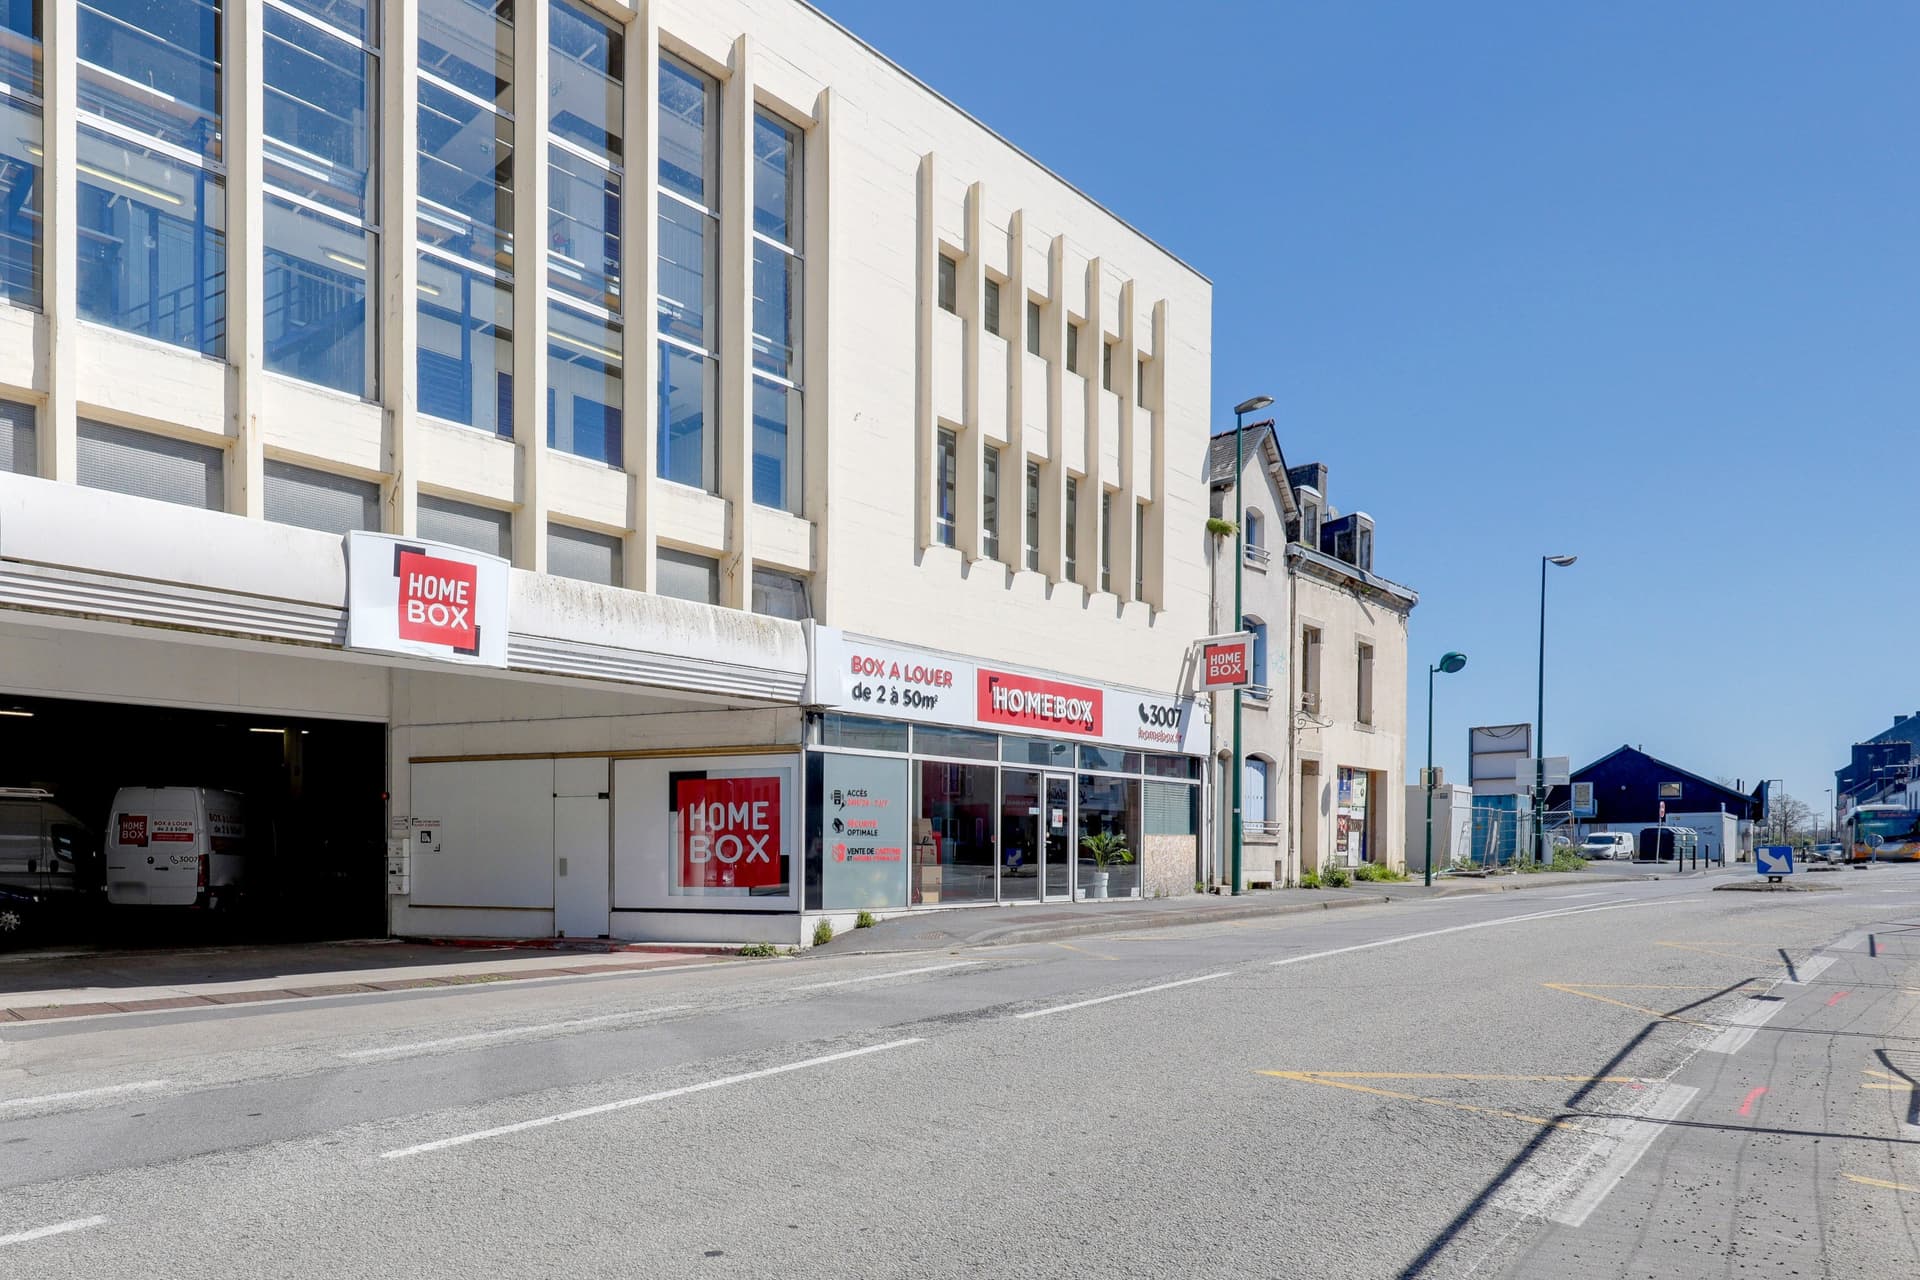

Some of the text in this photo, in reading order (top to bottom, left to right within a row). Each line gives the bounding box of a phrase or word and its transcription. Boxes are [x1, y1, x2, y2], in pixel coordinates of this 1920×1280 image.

[408, 572, 470, 605] HOME
[407, 599, 469, 630] BOX
[1210, 652, 1241, 665] HOME
[1210, 664, 1241, 677] BOX
[851, 655, 953, 688] BOX A LOUER
[852, 681, 872, 702] de
[876, 685, 886, 704] 2
[890, 686, 899, 706] à
[992, 686, 1093, 723] HOMEBOX
[1149, 704, 1182, 729] 3007
[847, 788, 868, 798] ACCÈS
[122, 821, 145, 831] HOME
[689, 801, 769, 832] HOME
[122, 830, 145, 839] BOX
[847, 829, 878, 837] OPTIMALE
[179, 855, 198, 863] 3007
[689, 834, 770, 864] BOX
